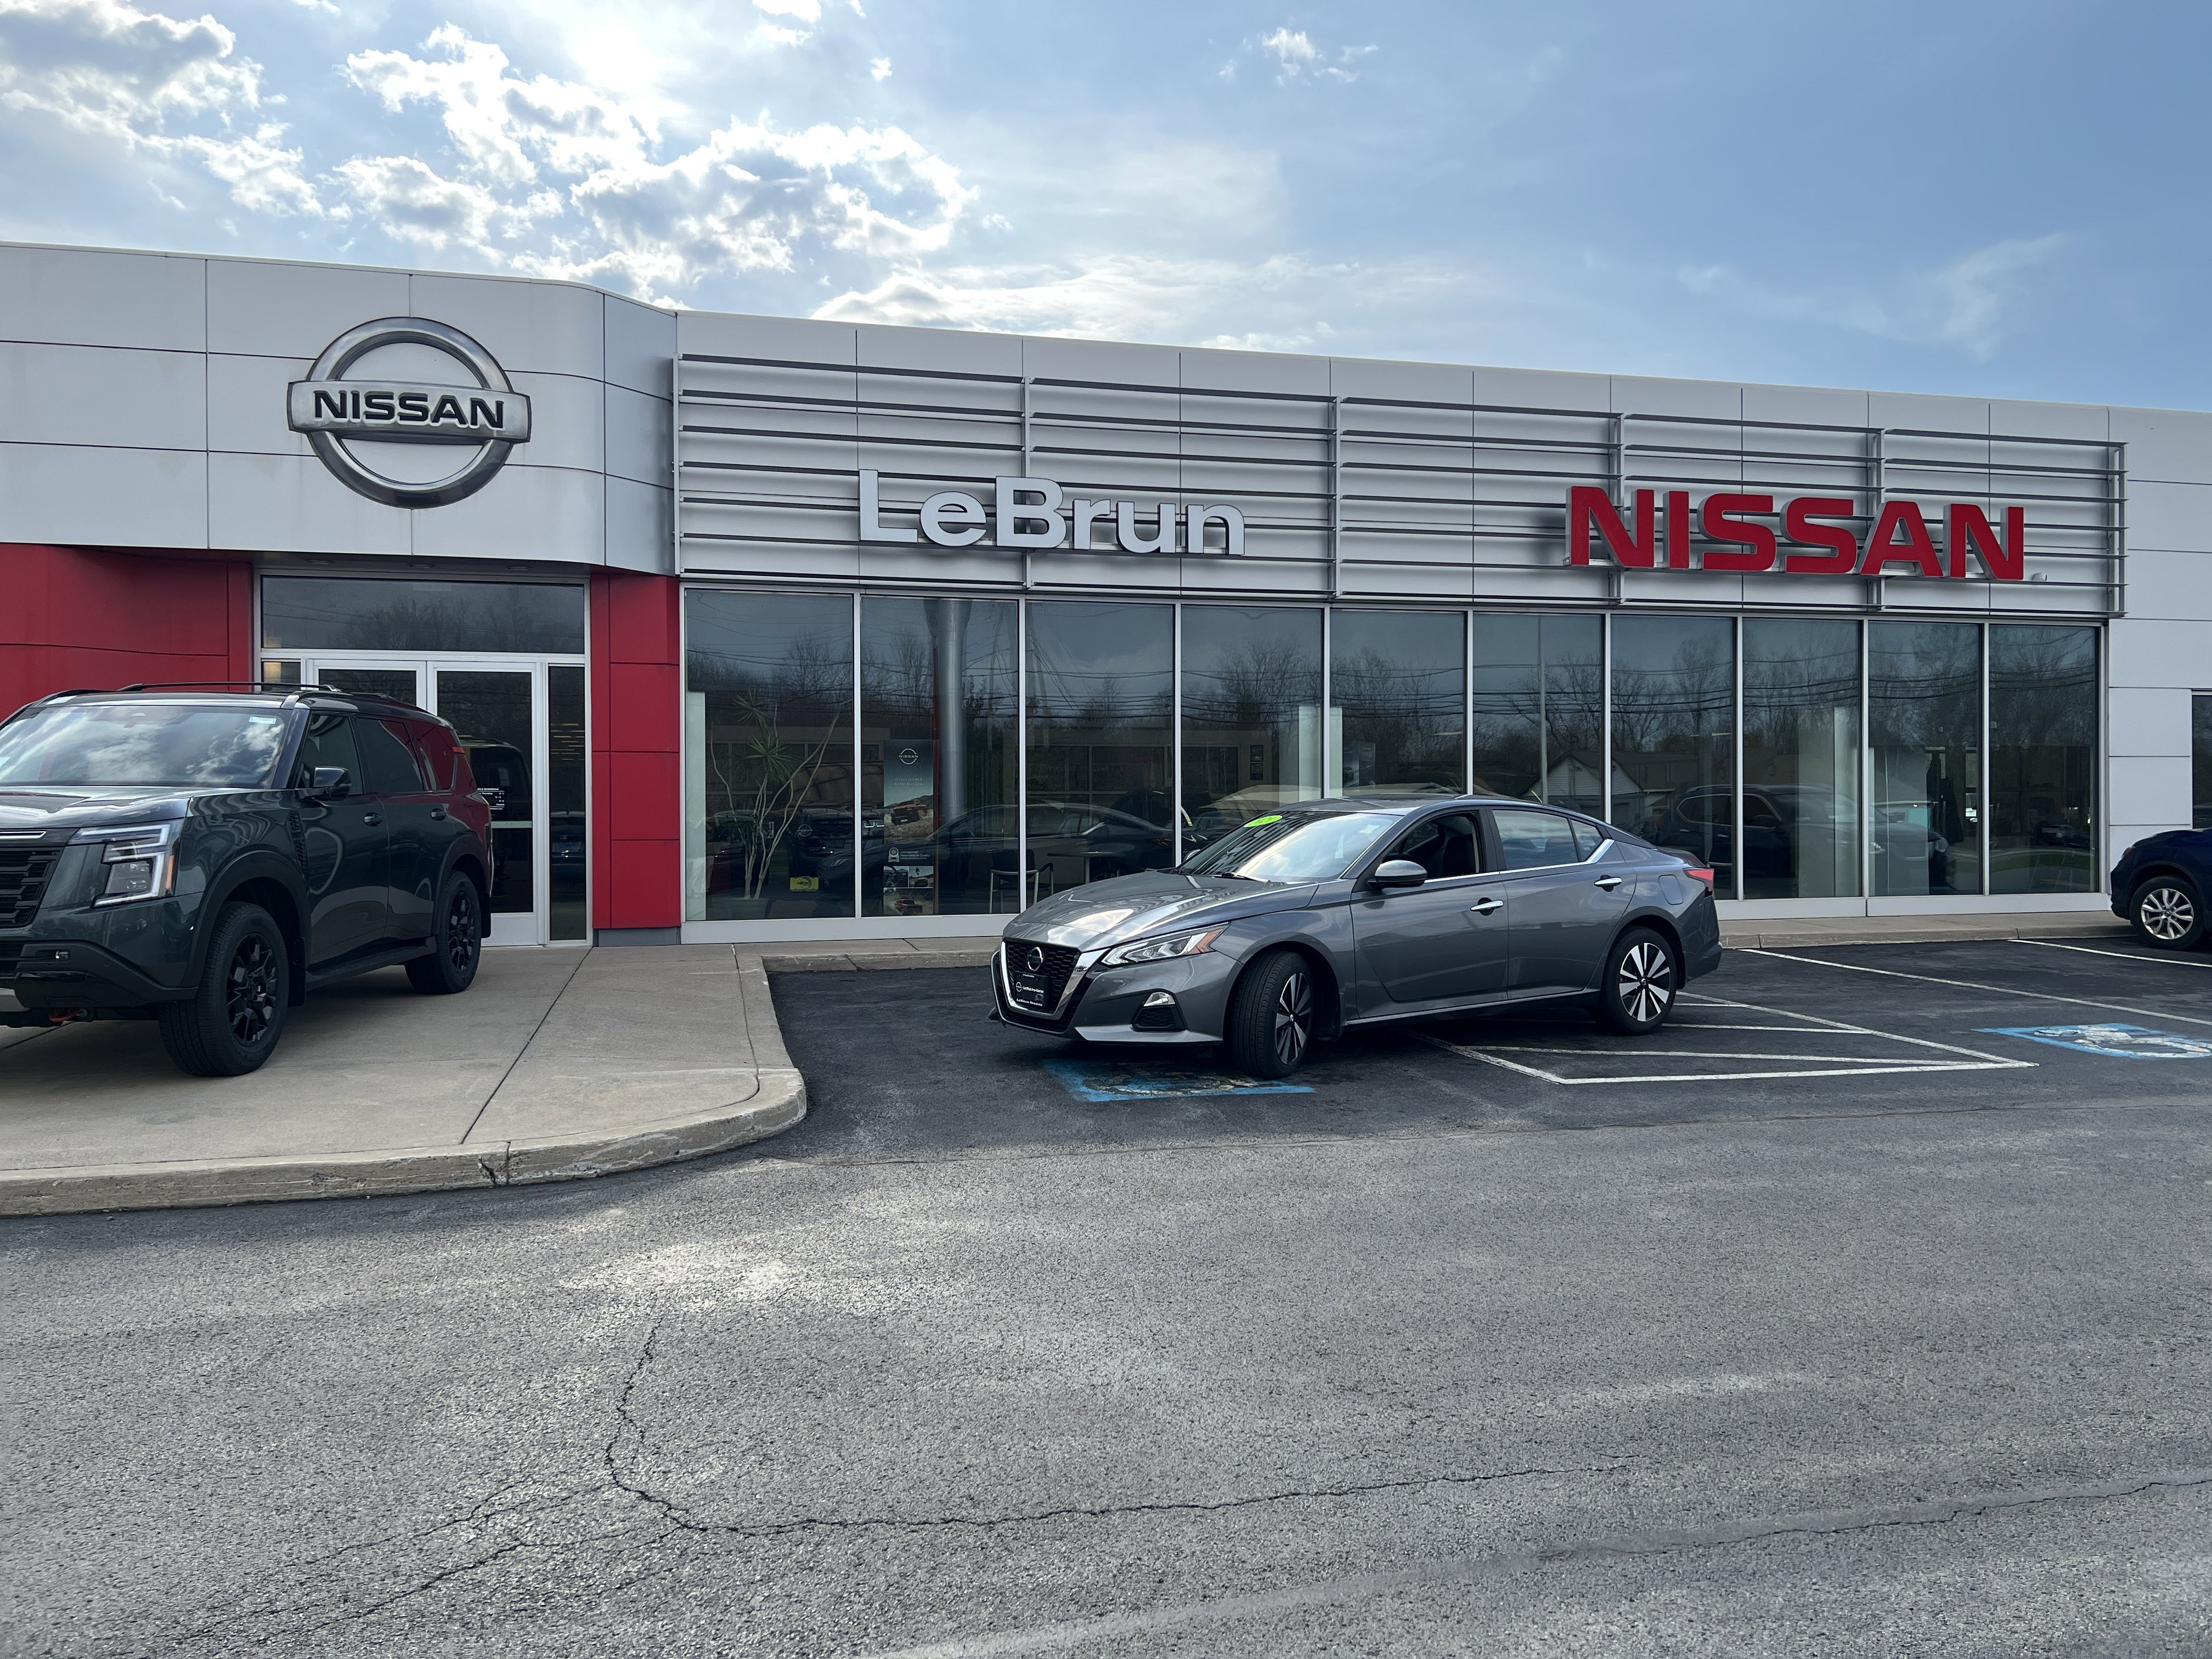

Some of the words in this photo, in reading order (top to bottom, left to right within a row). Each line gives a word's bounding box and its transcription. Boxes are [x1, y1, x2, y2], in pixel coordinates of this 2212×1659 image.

[314, 390, 504, 430] NISSAN
[859, 469, 1245, 555] LeBrun
[1565, 486, 2024, 580] NISSAN
